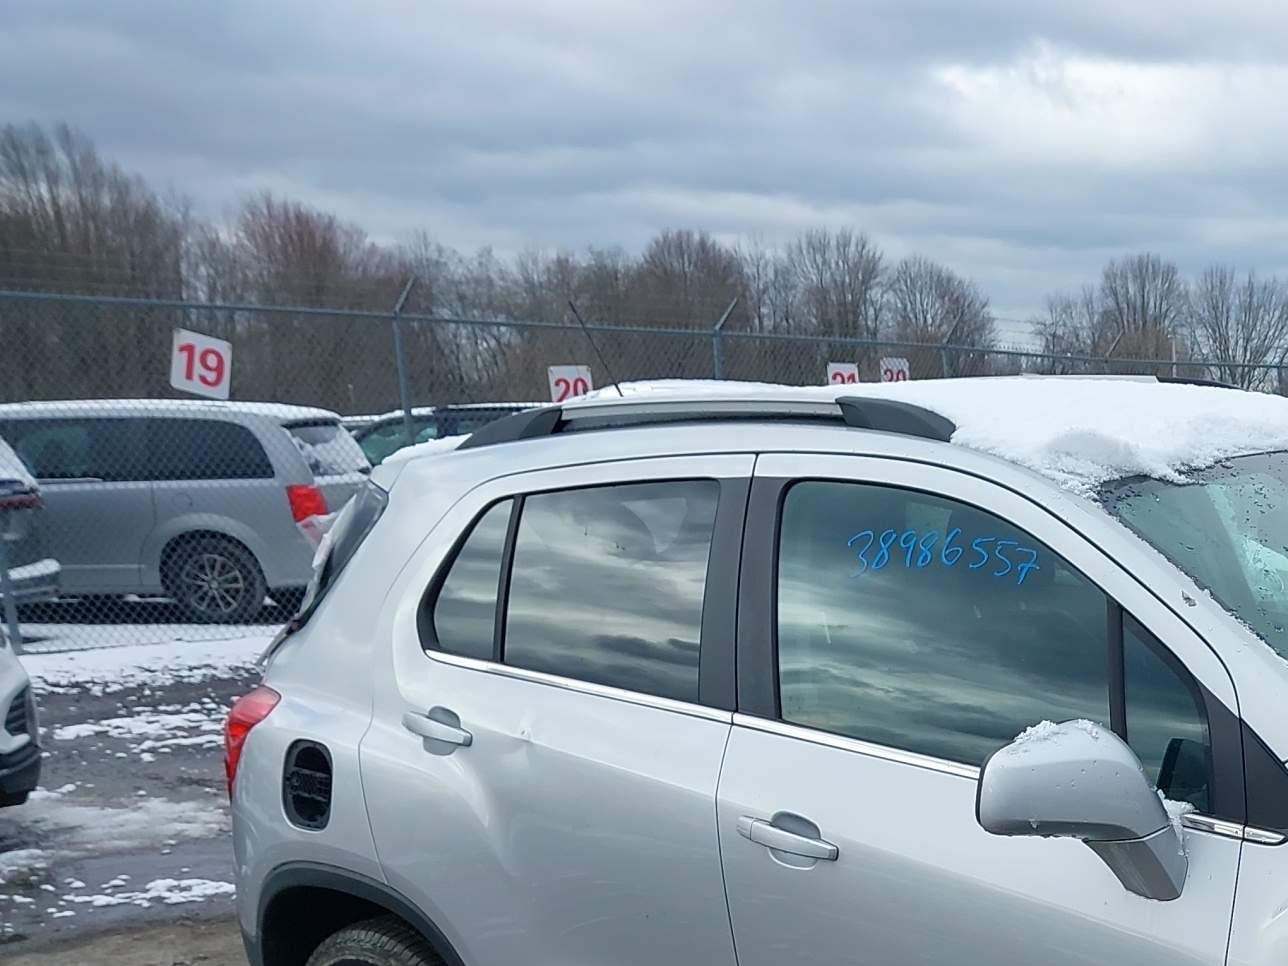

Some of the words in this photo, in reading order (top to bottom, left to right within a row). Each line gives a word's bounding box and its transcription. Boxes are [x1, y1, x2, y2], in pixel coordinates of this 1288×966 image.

[178, 343, 225, 387] 19
[554, 377, 589, 402] 20
[847, 528, 1040, 584] 38986557
